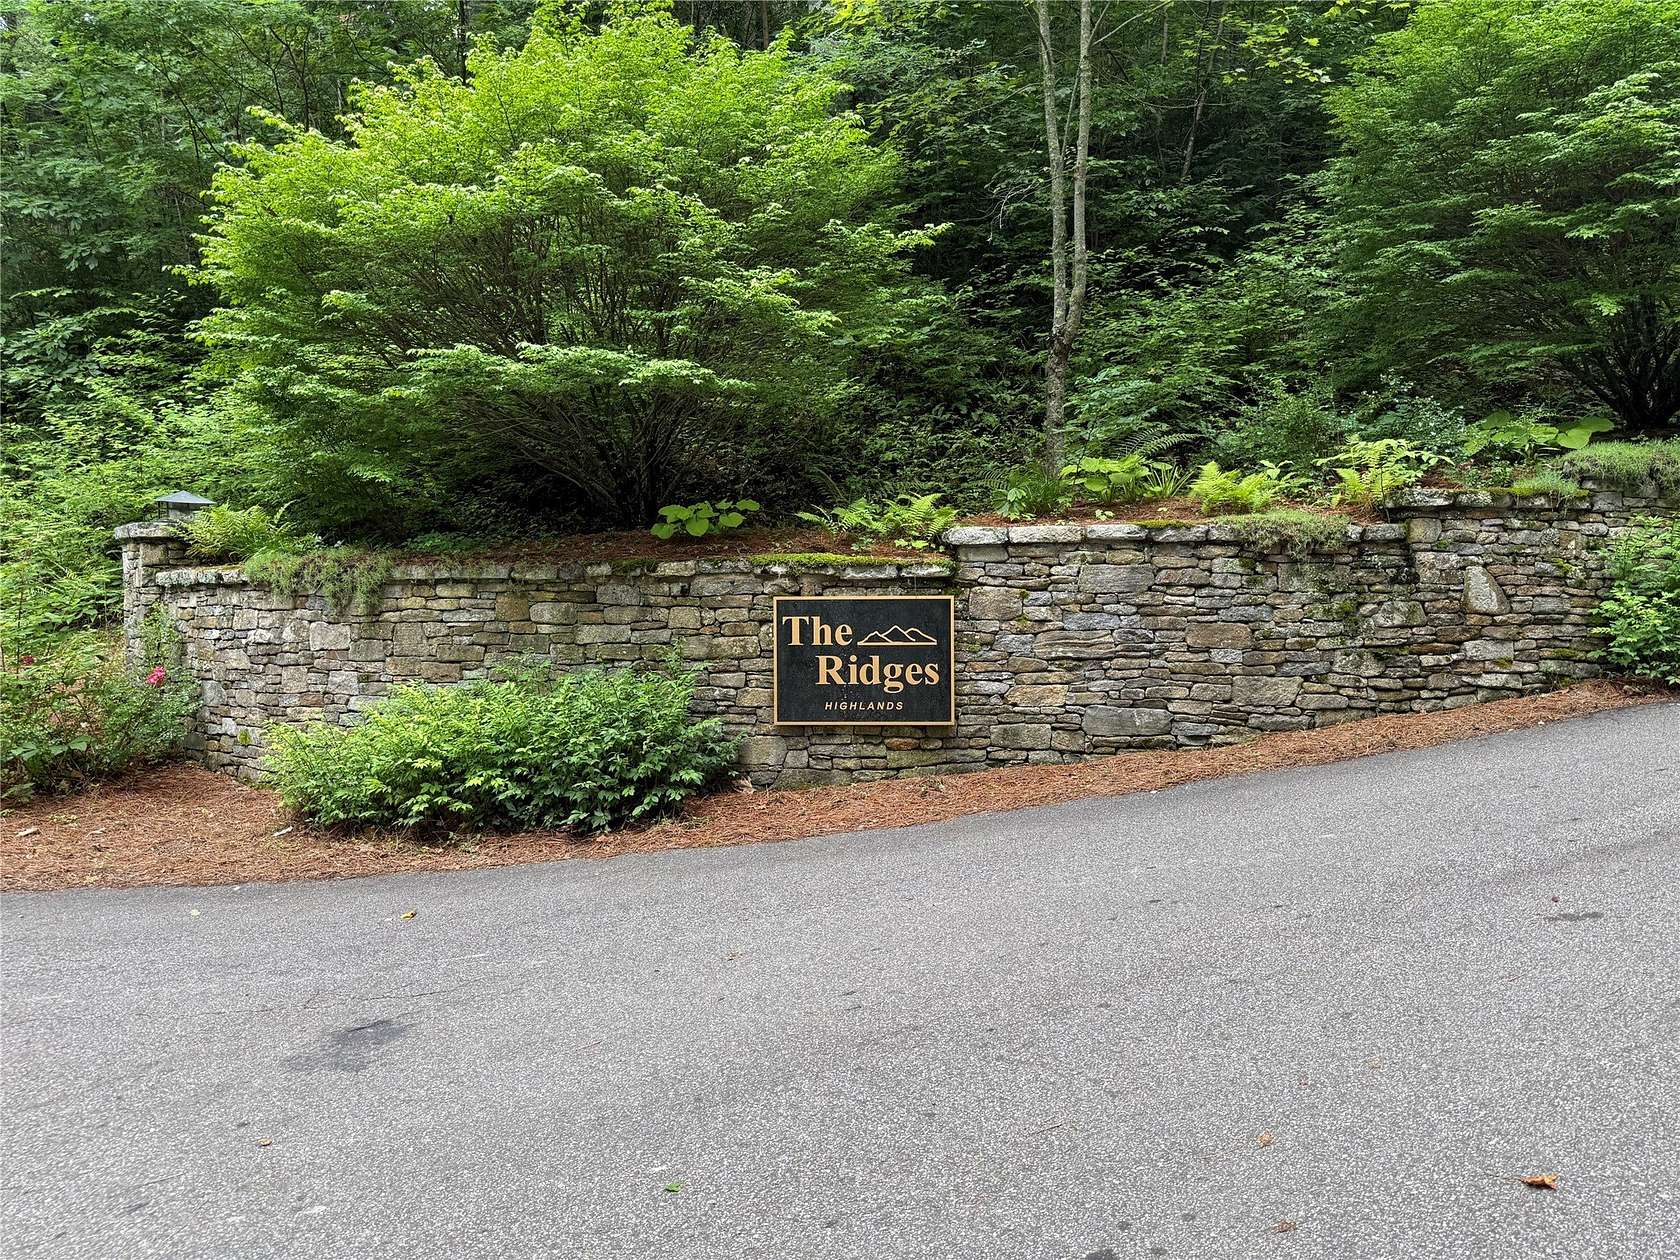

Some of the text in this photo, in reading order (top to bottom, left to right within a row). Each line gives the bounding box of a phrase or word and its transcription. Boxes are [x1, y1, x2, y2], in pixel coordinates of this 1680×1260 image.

[782, 615, 853, 646] The
[816, 655, 940, 694] Ridges
[824, 701, 904, 711] HIGHLANDS
